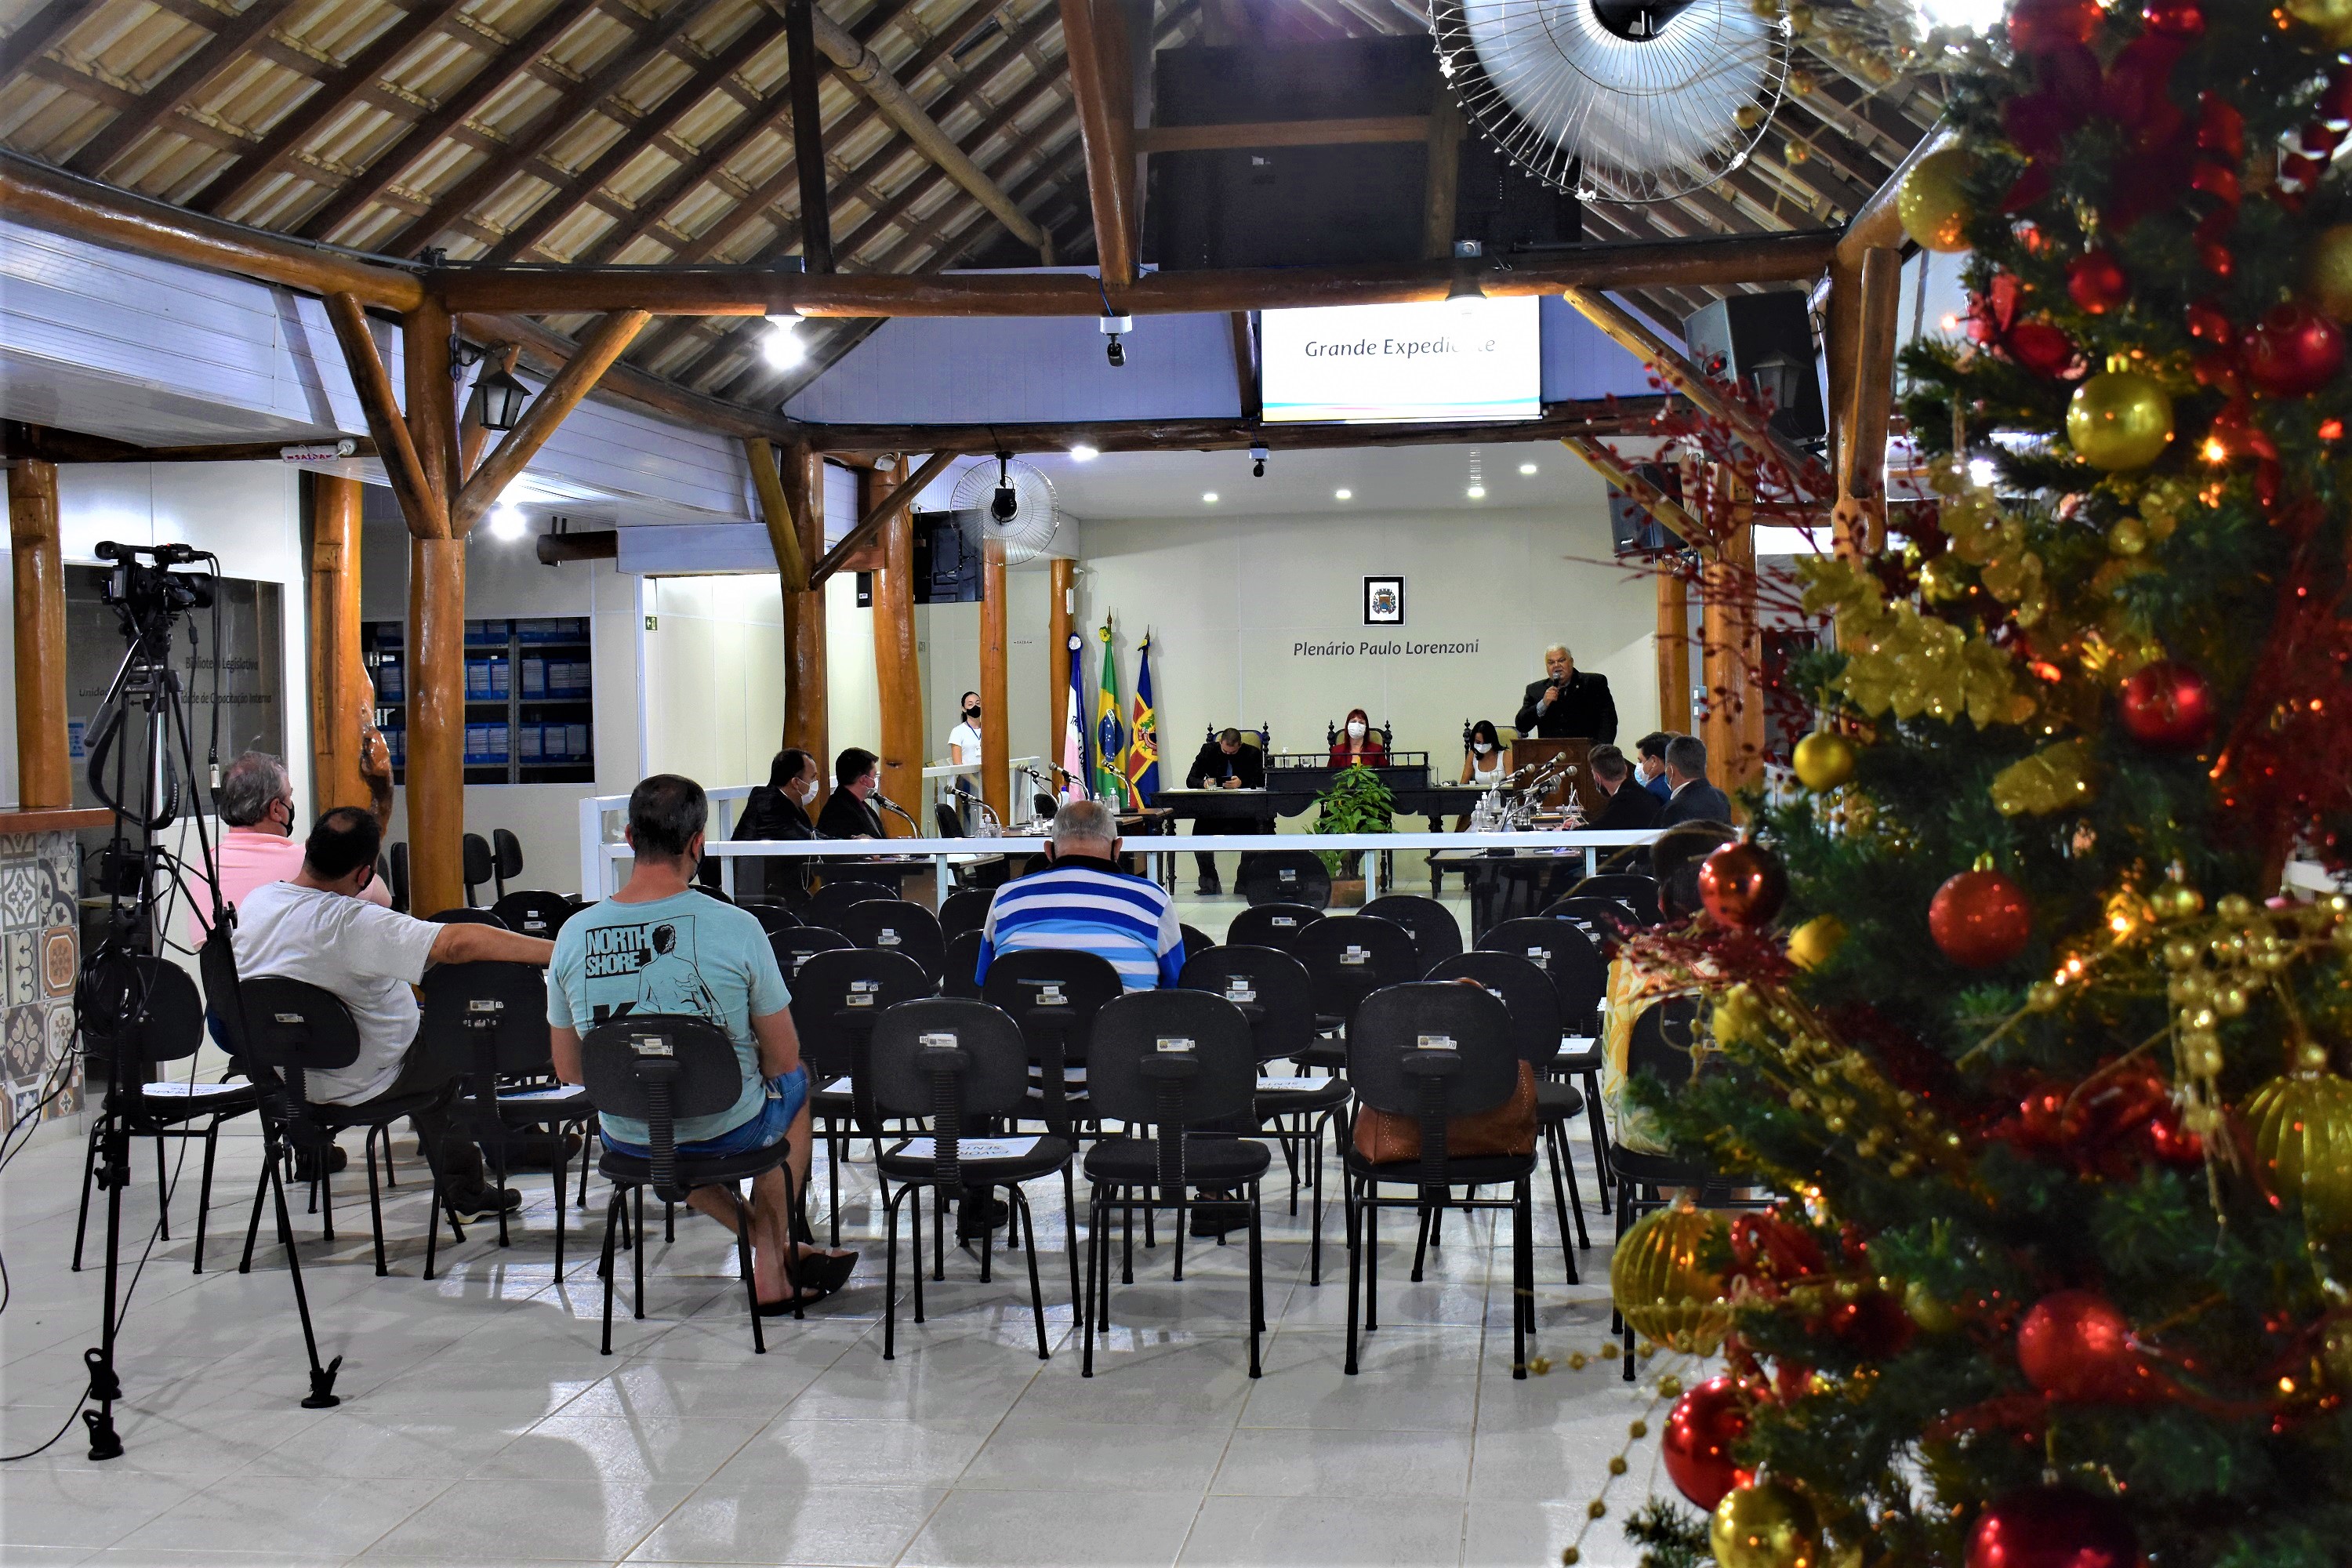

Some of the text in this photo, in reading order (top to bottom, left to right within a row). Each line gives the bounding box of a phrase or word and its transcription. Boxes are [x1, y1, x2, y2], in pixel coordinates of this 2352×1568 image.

[1305, 339, 1377, 357] Grande
[1294, 638, 1479, 656] Plenário Paulo Lorenzoni
[210, 691, 249, 707] Cpacitação
[587, 925, 650, 956] NORTH
[586, 949, 641, 977] SHORE
